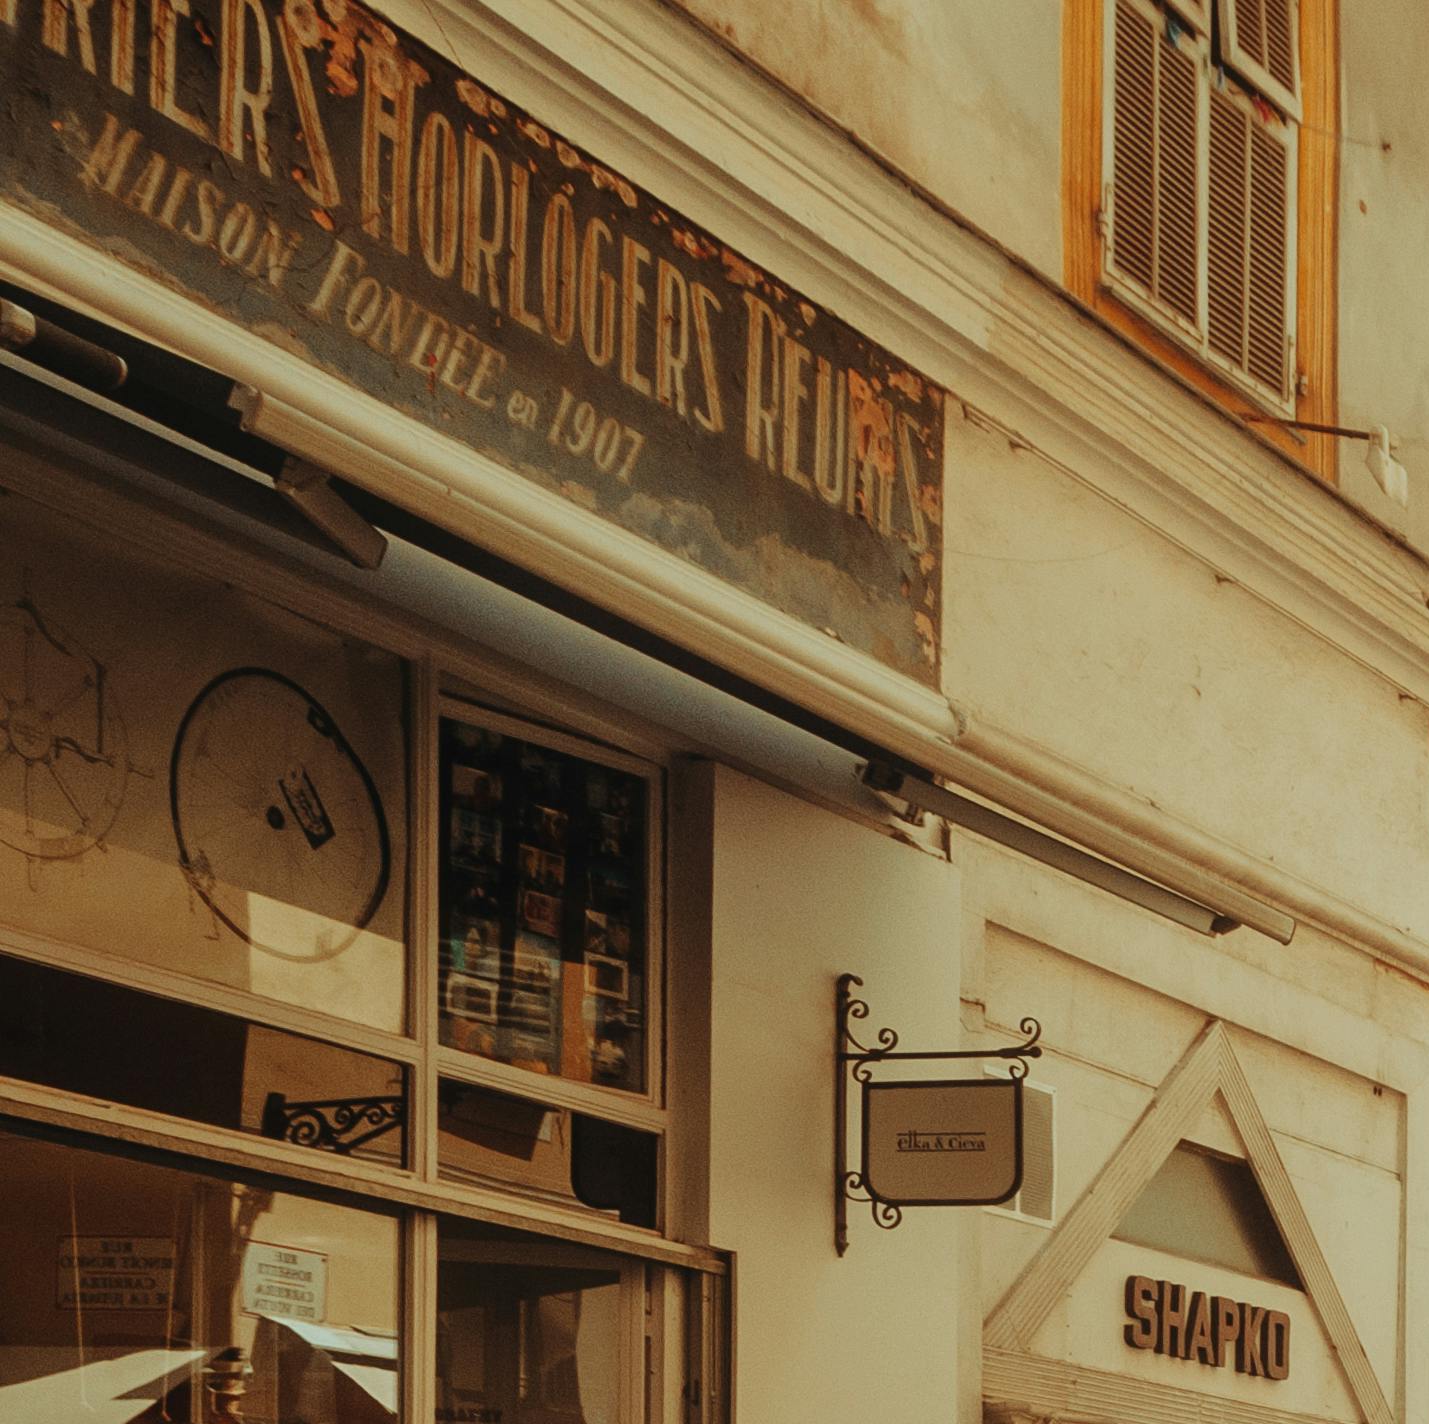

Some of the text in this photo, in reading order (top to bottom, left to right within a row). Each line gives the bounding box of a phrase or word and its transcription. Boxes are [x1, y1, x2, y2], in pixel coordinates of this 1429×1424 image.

[77, 108, 303, 289] MAISON
[547, 385, 647, 485] 1907
[361, 38, 724, 433] HORLOGERS
[1123, 1274, 1291, 1382] SHAPKO
